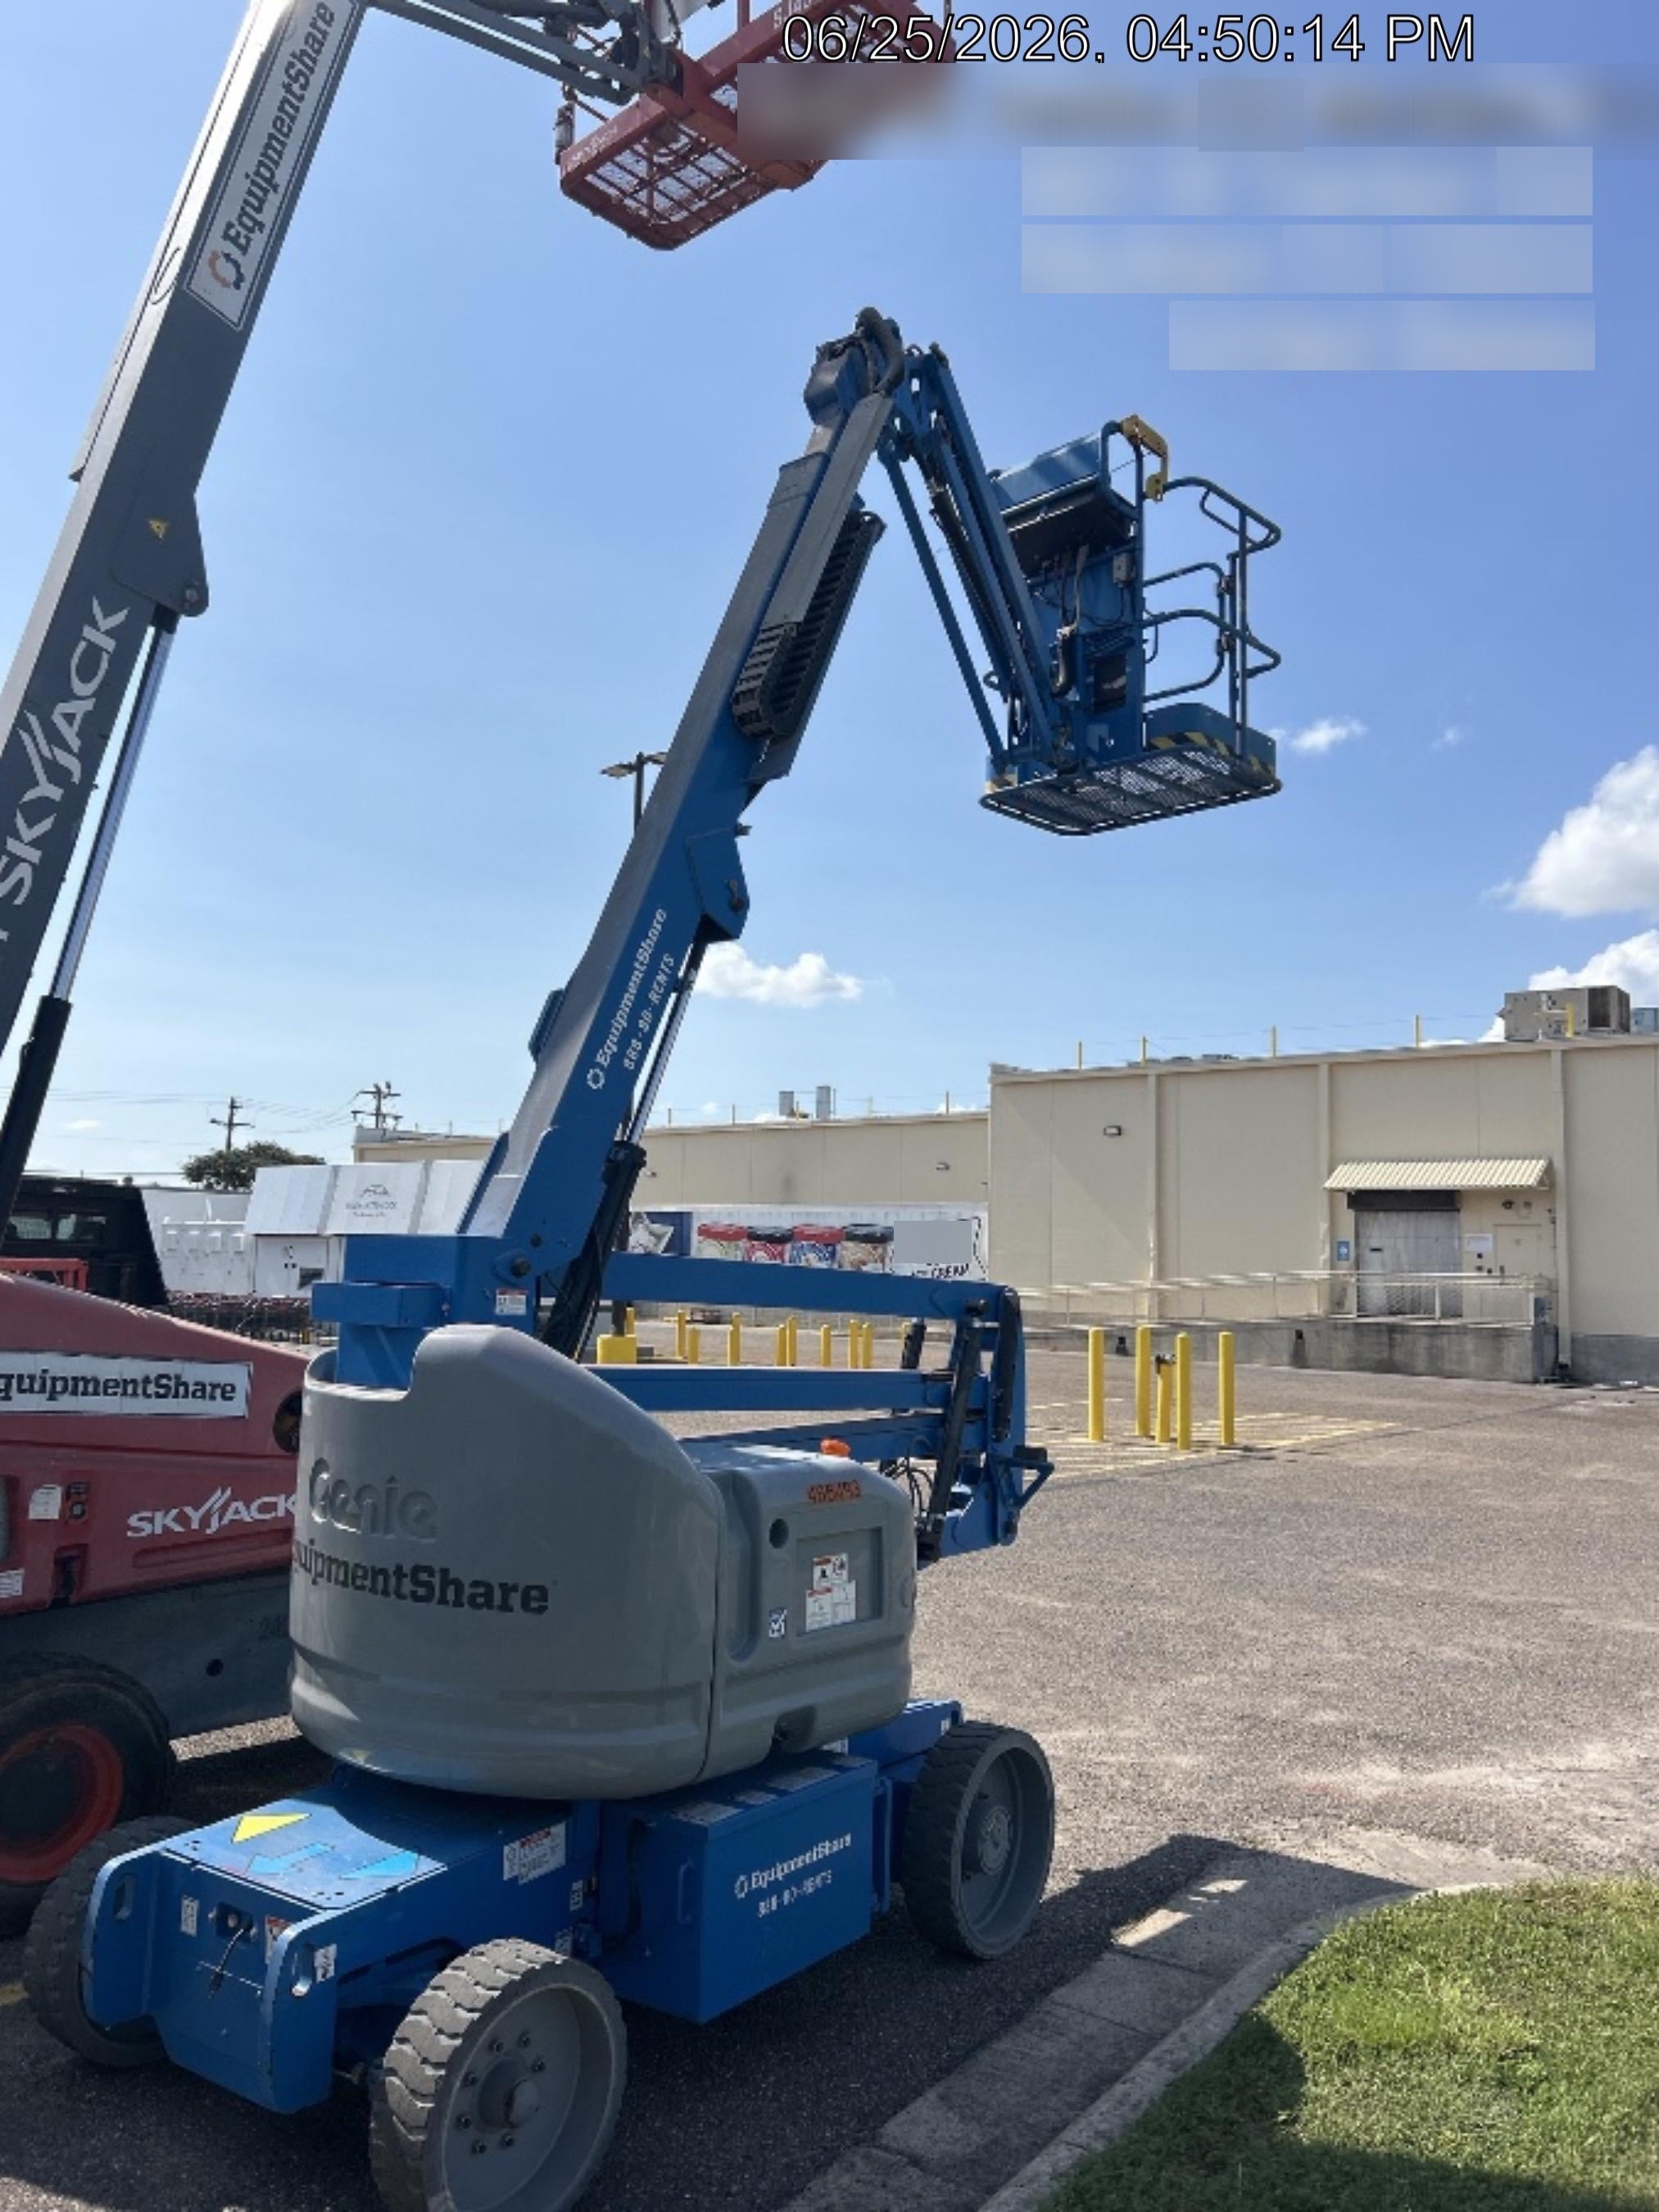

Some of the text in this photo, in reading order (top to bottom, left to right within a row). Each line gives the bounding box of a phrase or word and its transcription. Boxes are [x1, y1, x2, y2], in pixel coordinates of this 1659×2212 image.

[222, 1, 335, 256] EquipmentShare
[0, 596, 130, 905] SKYJACK
[596, 909, 666, 1067] EquipmentShare
[126, 1486, 297, 1538] SKYJACK
[310, 1457, 438, 1543] Genie
[292, 1538, 550, 1615] uipmentShare
[750, 1833, 852, 1890] EquipmentShare
